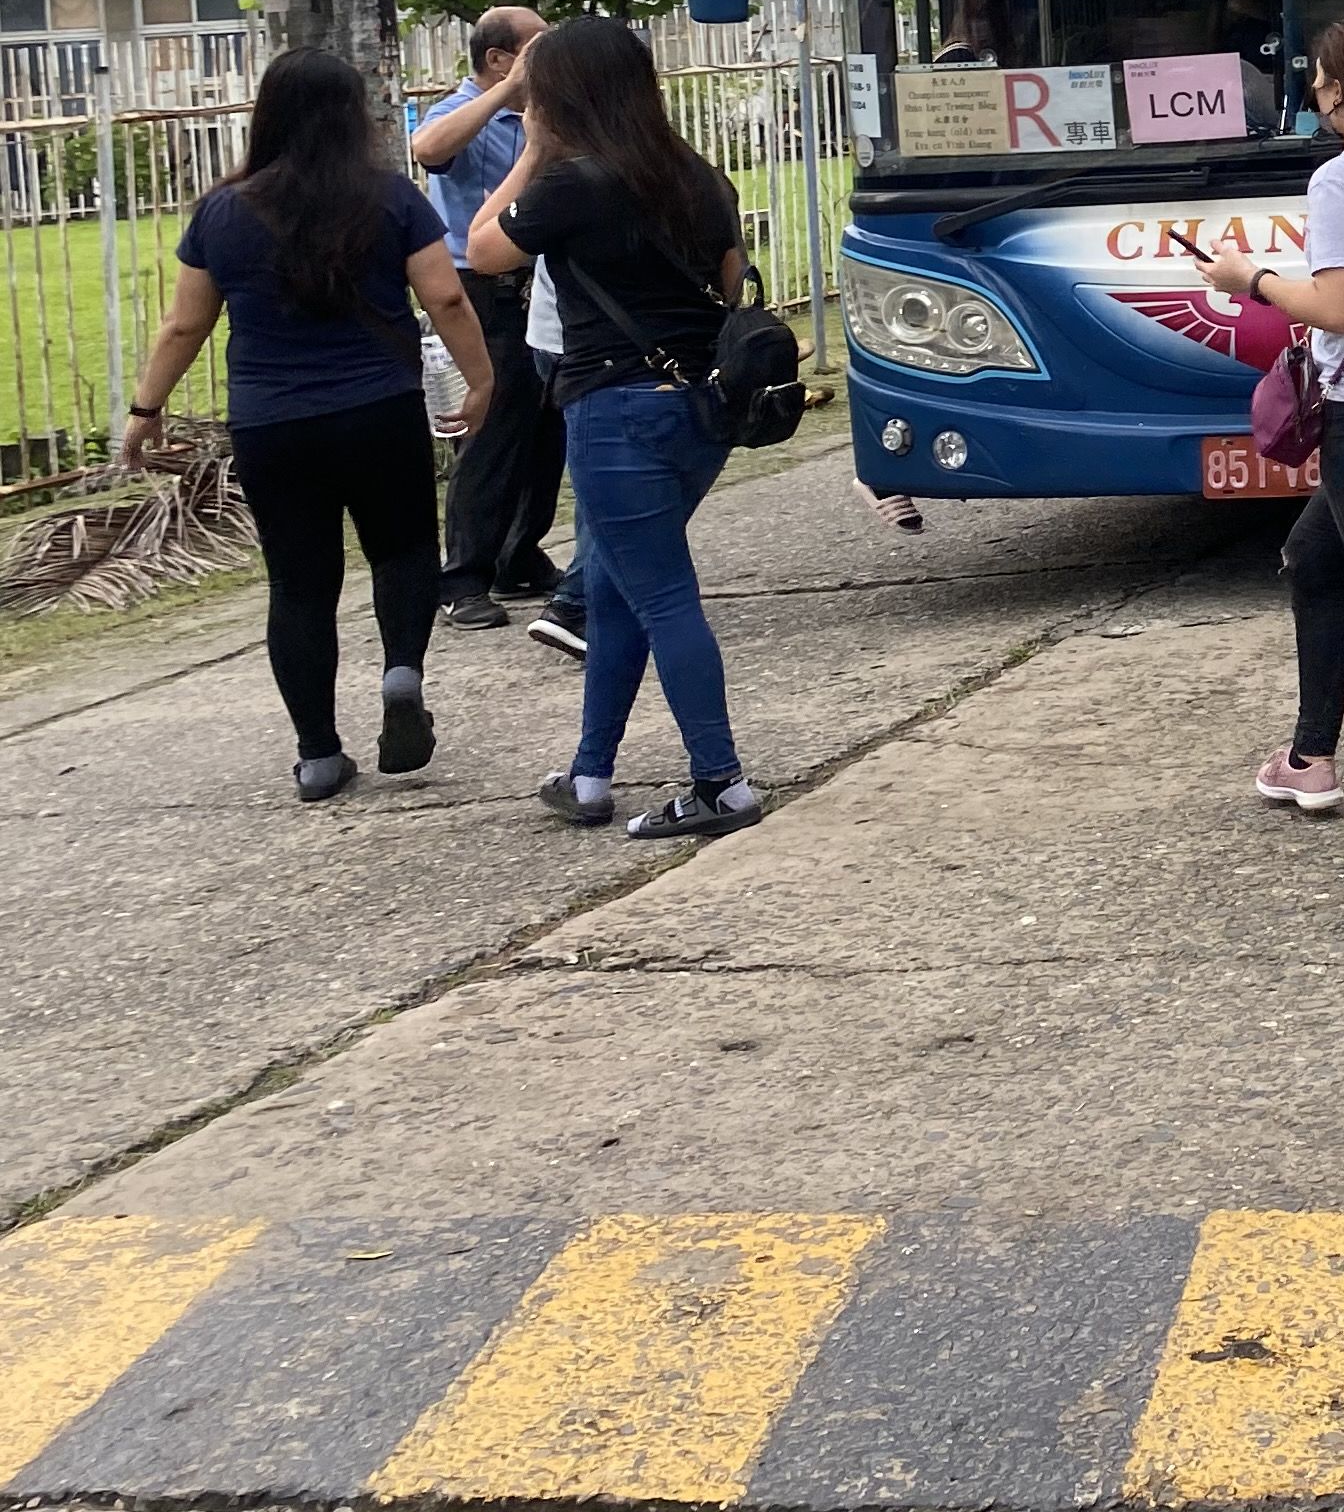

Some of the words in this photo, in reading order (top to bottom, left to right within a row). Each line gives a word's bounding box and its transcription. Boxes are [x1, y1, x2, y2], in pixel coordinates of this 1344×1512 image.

[1004, 72, 1063, 149] R
[1149, 89, 1226, 119] LCM
[1063, 119, 1113, 145] 專車
[1106, 214, 1309, 261] CHAN
